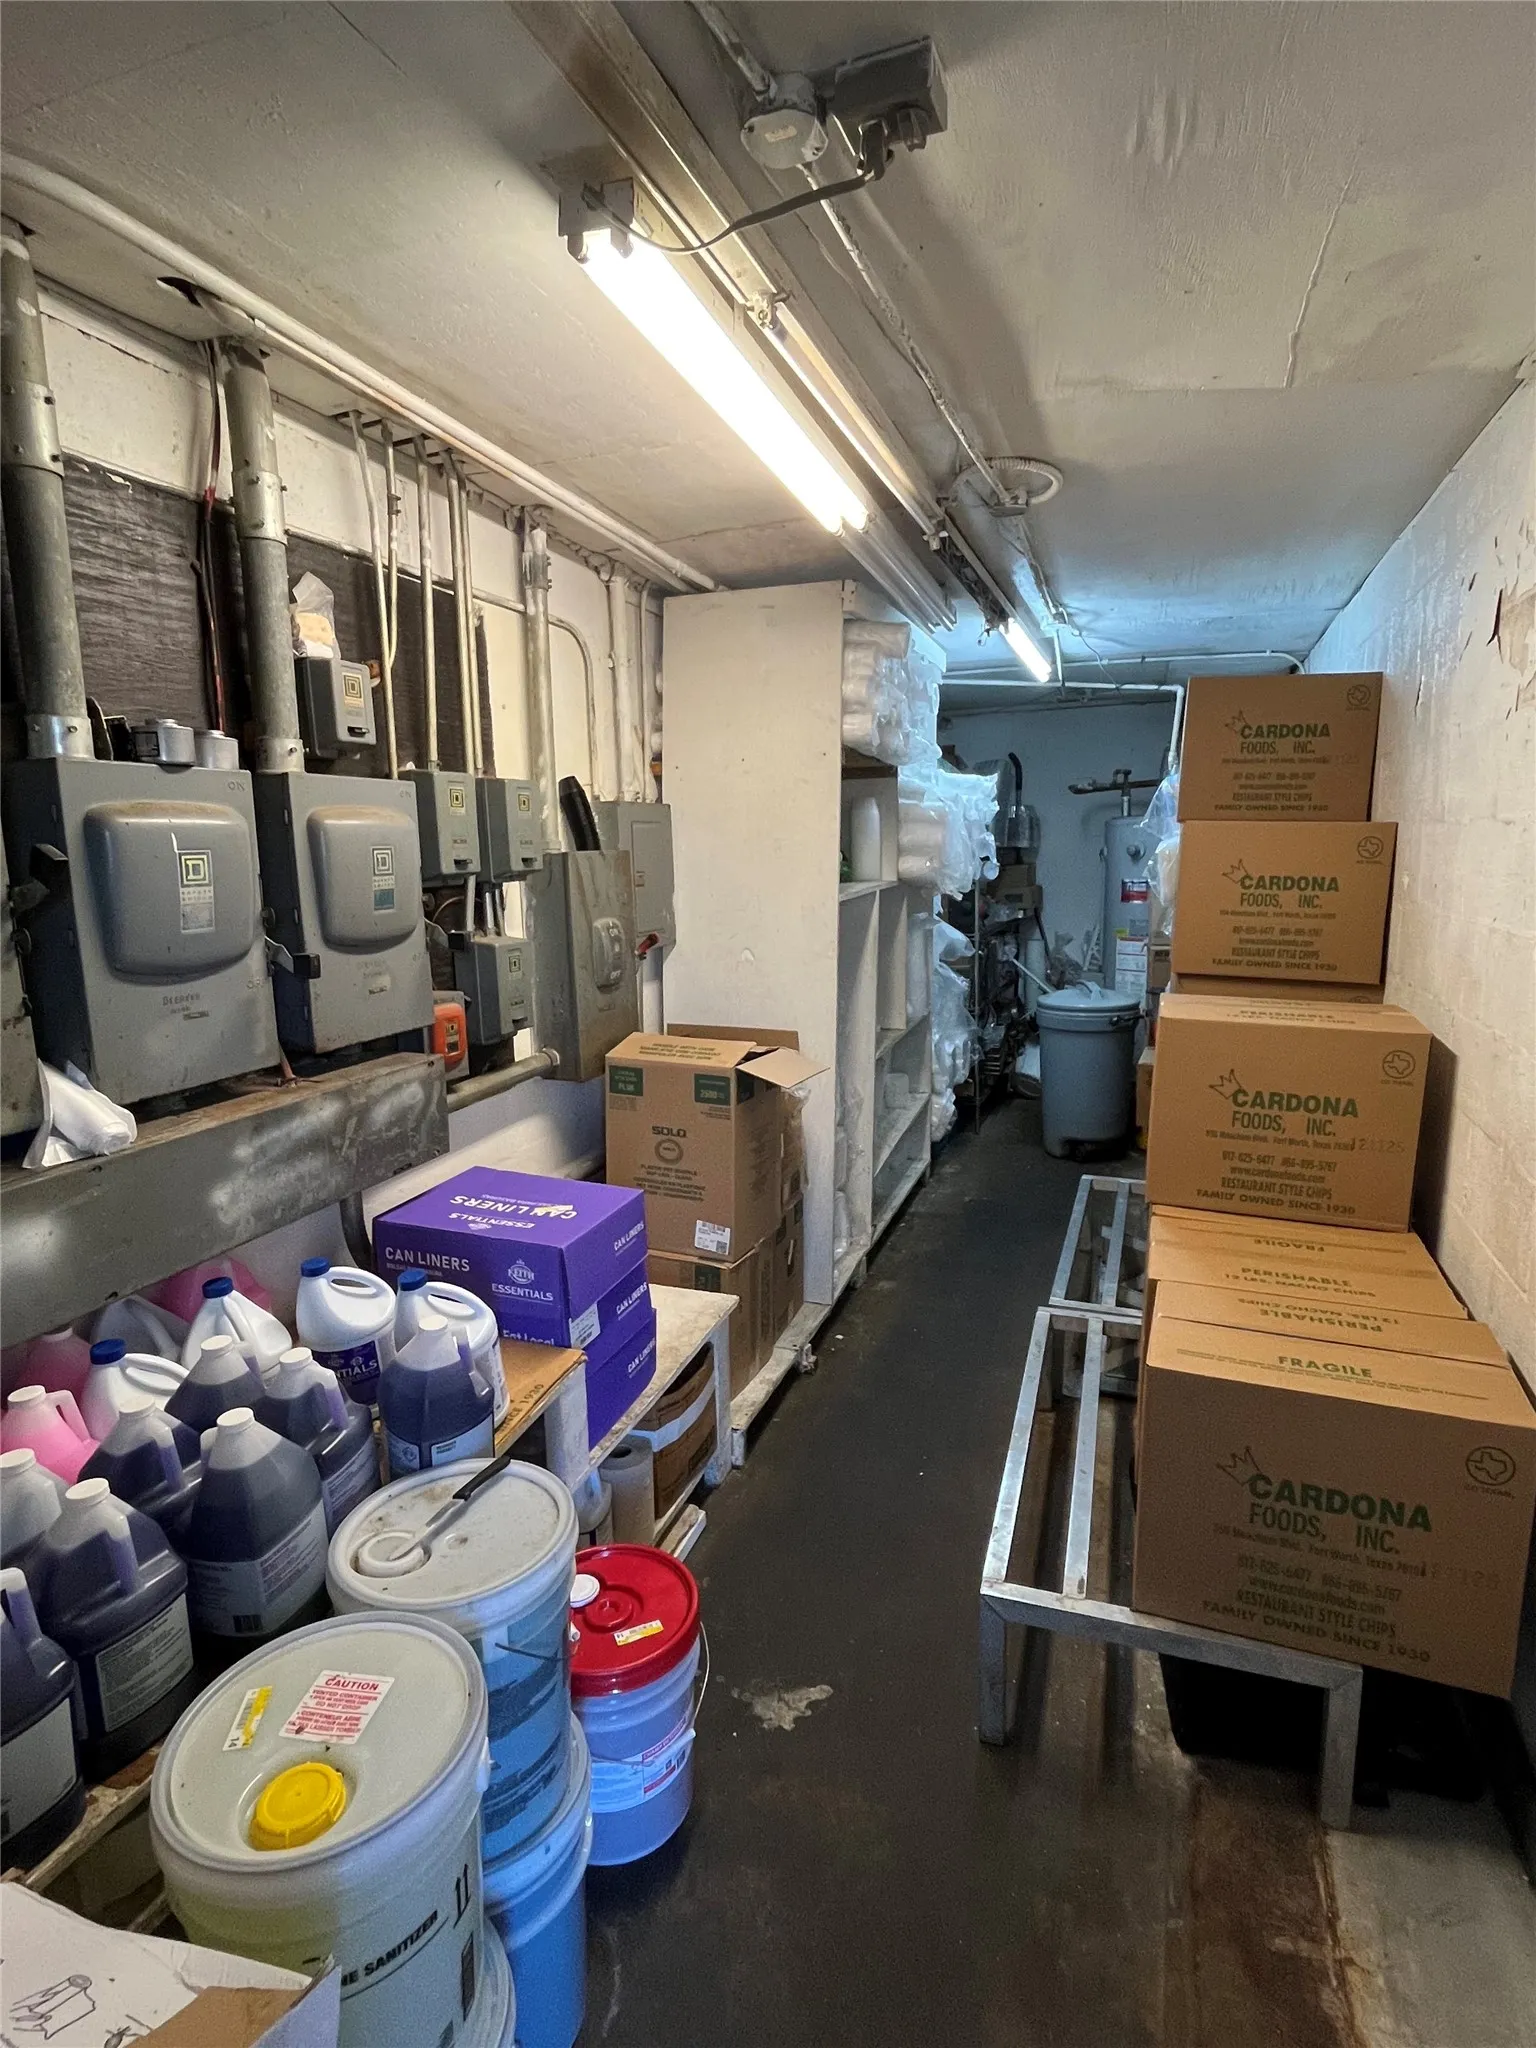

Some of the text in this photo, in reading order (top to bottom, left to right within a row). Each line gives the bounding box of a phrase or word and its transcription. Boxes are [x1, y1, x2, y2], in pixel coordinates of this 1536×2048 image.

[1240, 723, 1331, 740] CARDONA
[1240, 741, 1316, 754] FOODS, INC.
[1240, 875, 1339, 892] CARDONA
[1240, 892, 1323, 909] FOODS, INC.
[1285, 961, 1311, 970] SINCE
[1232, 1088, 1359, 1118] CARDONA
[651, 1125, 687, 1138] SOLO
[1232, 1110, 1286, 1134] FOODS,
[1306, 1117, 1336, 1137] INC.
[1221, 1176, 1332, 1200] RESTAURANT STYLE CHIPS
[450, 1195, 531, 1215] LINERS
[1196, 1188, 1235, 1201] FAMILY
[1239, 1193, 1284, 1207] OWNED
[1288, 1199, 1321, 1211] SINCE
[448, 1212, 535, 1229] ESSENTIALS
[614, 1237, 627, 1251] CAN
[385, 1247, 414, 1264] CAN
[417, 1251, 470, 1272] LINERS
[1241, 1266, 1352, 1287] PERISHABLE
[491, 1283, 554, 1301] ESSENTIALS
[1333, 1286, 1376, 1298] CHIPS
[616, 1302, 628, 1314] CAN
[1260, 1308, 1383, 1333] PERISHABLE
[1278, 1355, 1373, 1379] FRAGILE
[520, 1383, 545, 1405] 1930
[1248, 1473, 1432, 1533] CARDONA
[1249, 1502, 1400, 1555] FOODS, INC.
[1236, 1589, 1397, 1635] RESTAURANT STYLE CHIPS
[1202, 1599, 1431, 1663] FAMILY OWNED SINCE 1930
[325, 1678, 380, 1691] CAUTION
[364, 1908, 438, 1978] SANITIZER
